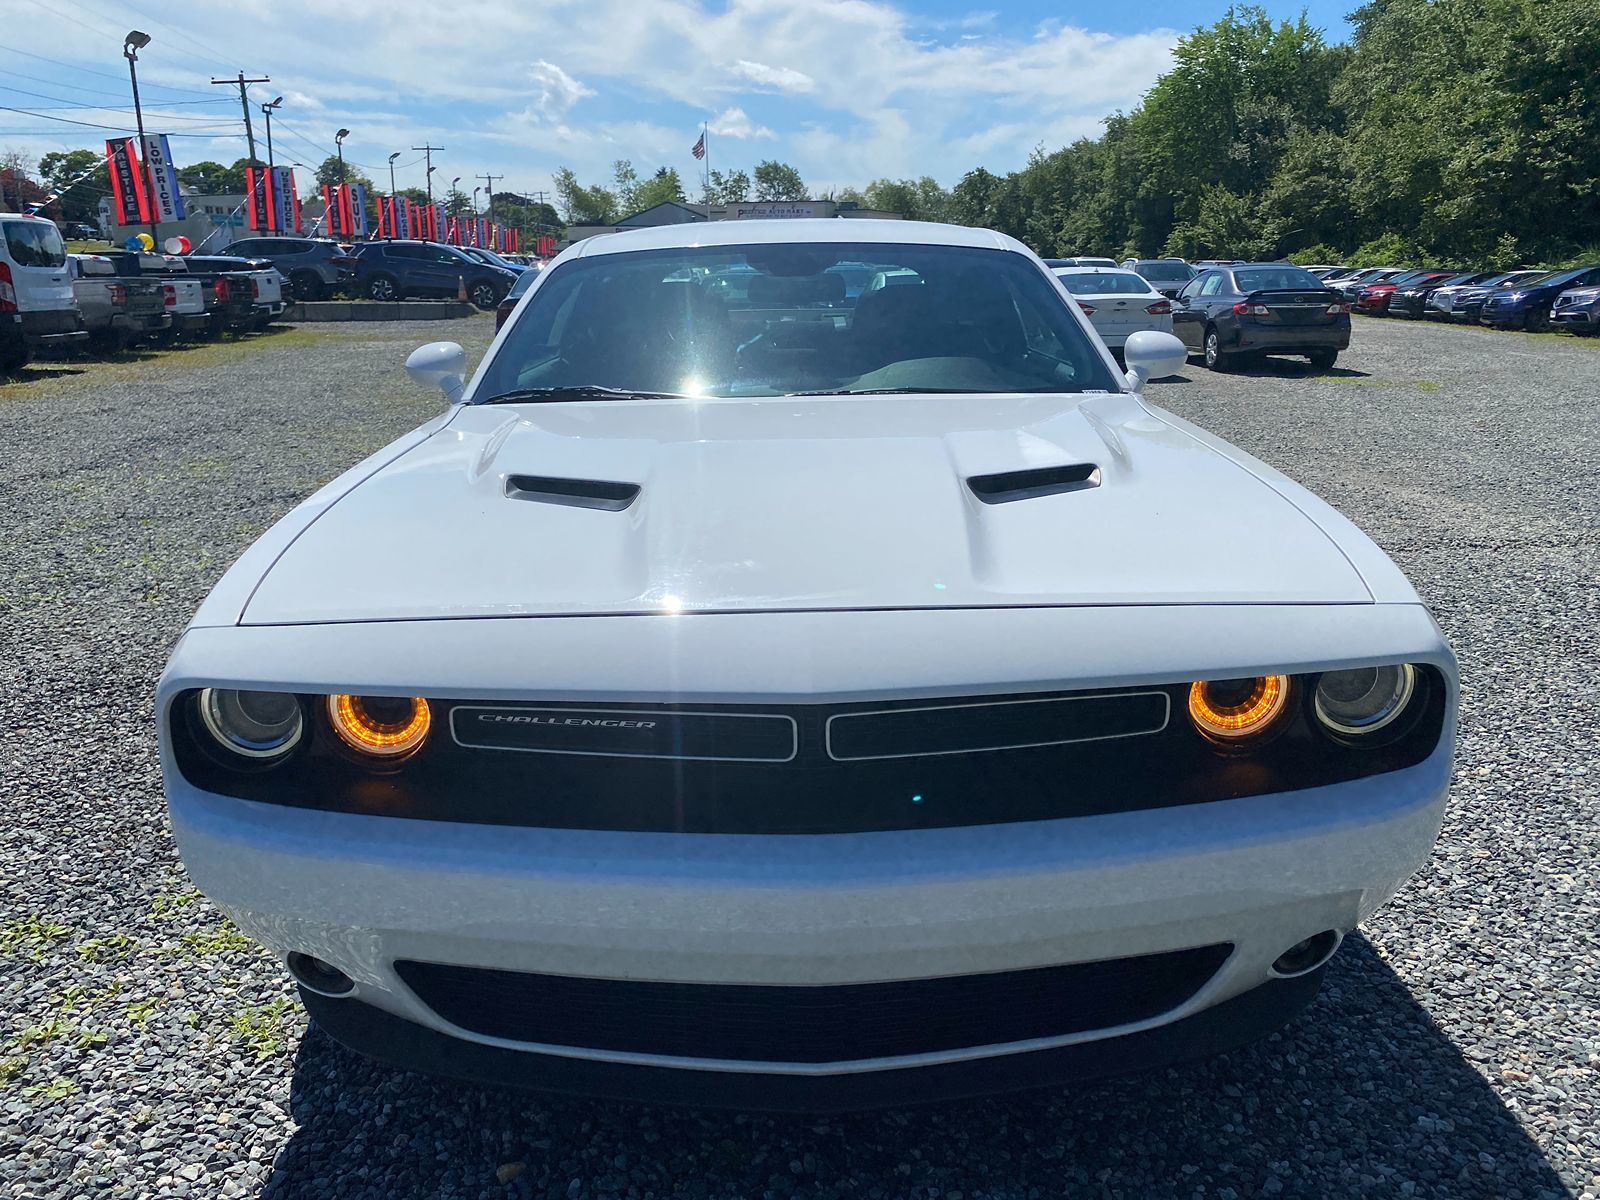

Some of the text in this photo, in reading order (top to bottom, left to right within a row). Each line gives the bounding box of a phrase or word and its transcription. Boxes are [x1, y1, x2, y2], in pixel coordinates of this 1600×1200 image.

[114, 143, 135, 211] PRESTIGE
[150, 142, 172, 215] LOW PRICES
[284, 195, 293, 228] TRUCKS
[351, 188, 361, 230] SUV
[478, 714, 657, 729] CHALLENGER
